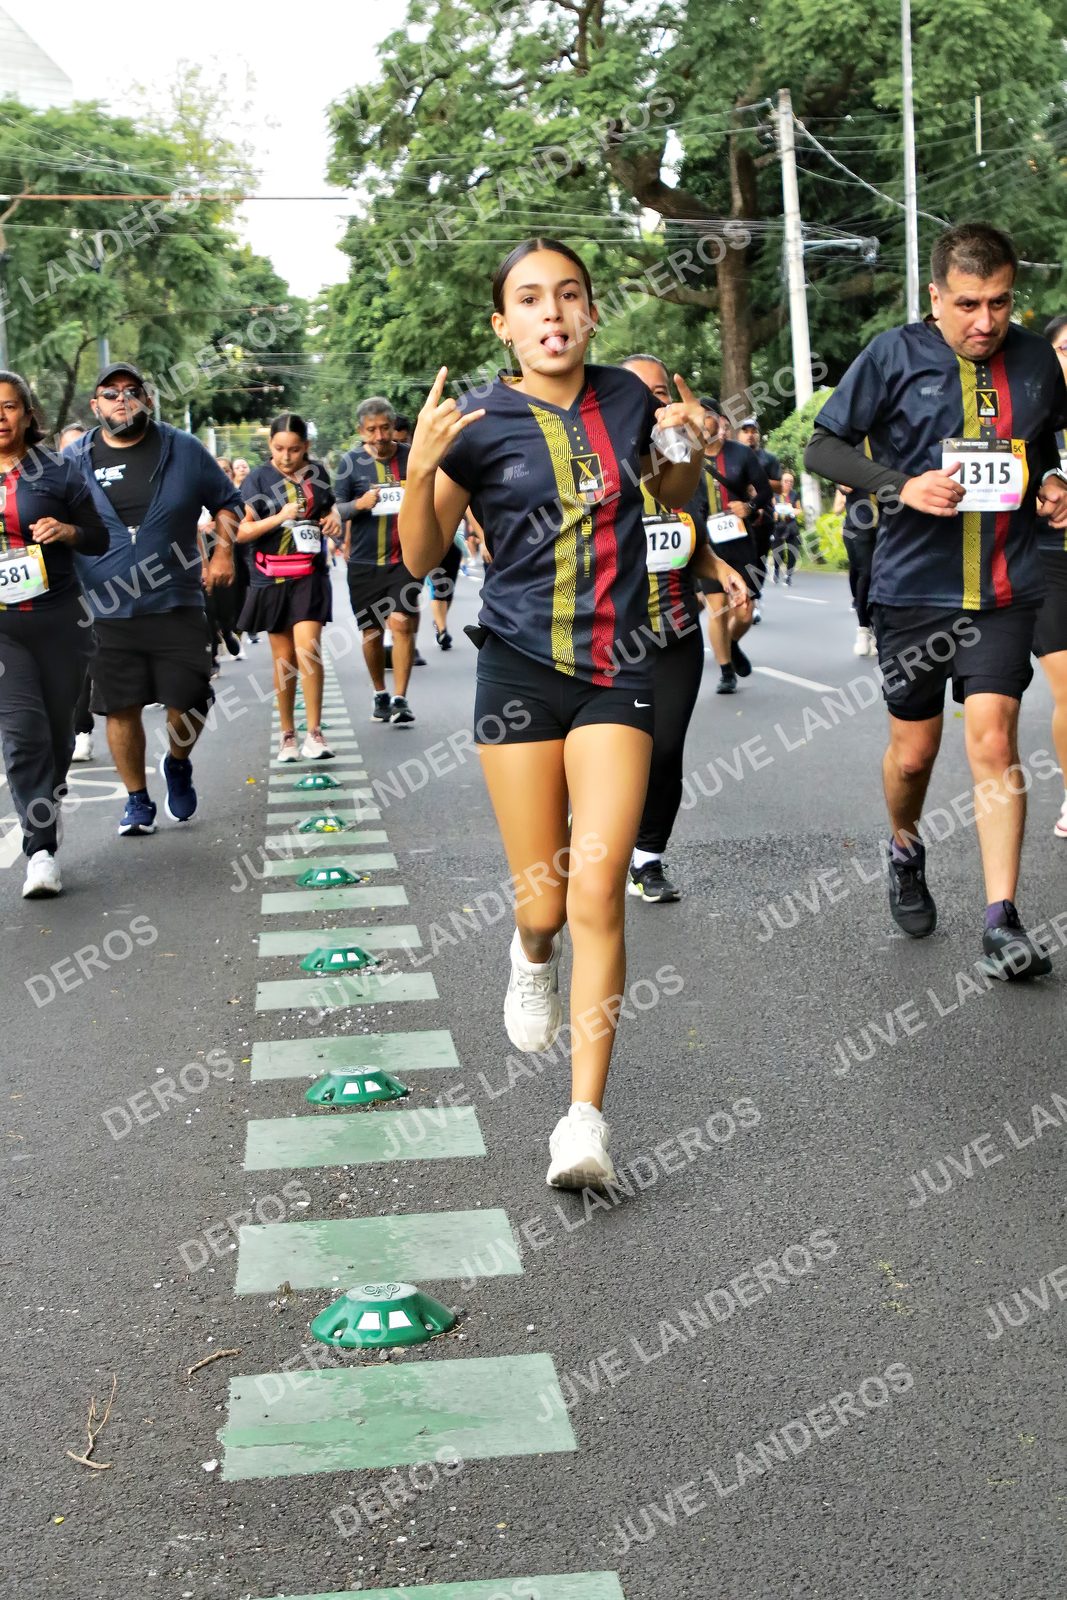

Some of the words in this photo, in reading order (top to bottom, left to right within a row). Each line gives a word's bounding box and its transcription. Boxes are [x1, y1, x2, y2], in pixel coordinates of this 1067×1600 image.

[959, 462, 1011, 485] 1315
[717, 519, 735, 531] 626
[648, 531, 682, 551] 120
[0, 563, 30, 586] 581
